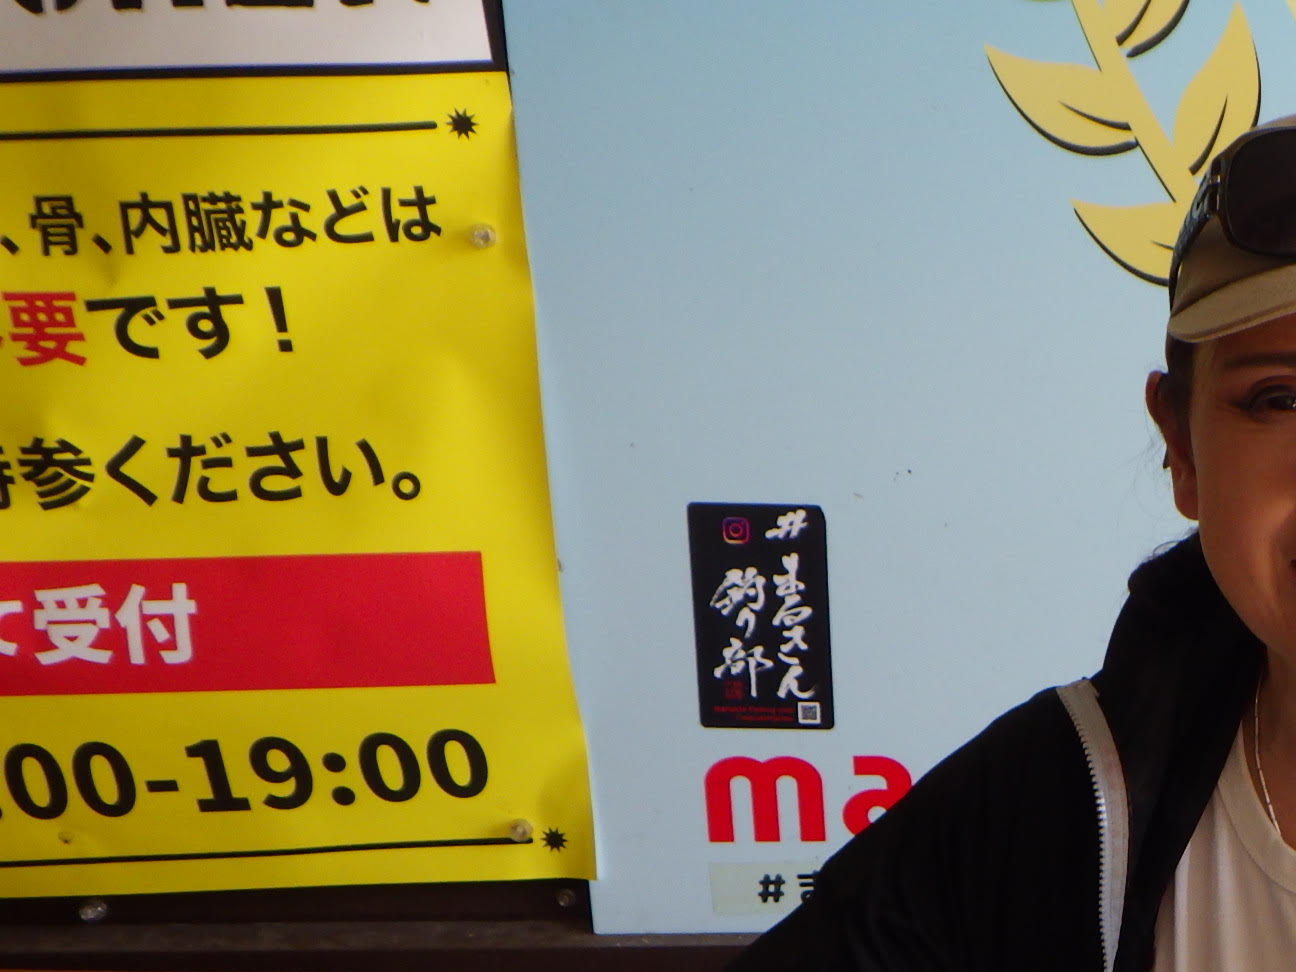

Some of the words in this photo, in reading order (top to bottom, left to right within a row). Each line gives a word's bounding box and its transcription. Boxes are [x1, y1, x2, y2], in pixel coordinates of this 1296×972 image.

[0, 185, 443, 257] 、骨、内臓などは
[0, 286, 295, 367] 要です！
[0, 431, 422, 511] 参ください。
[0, 728, 489, 821] 00-19:00
